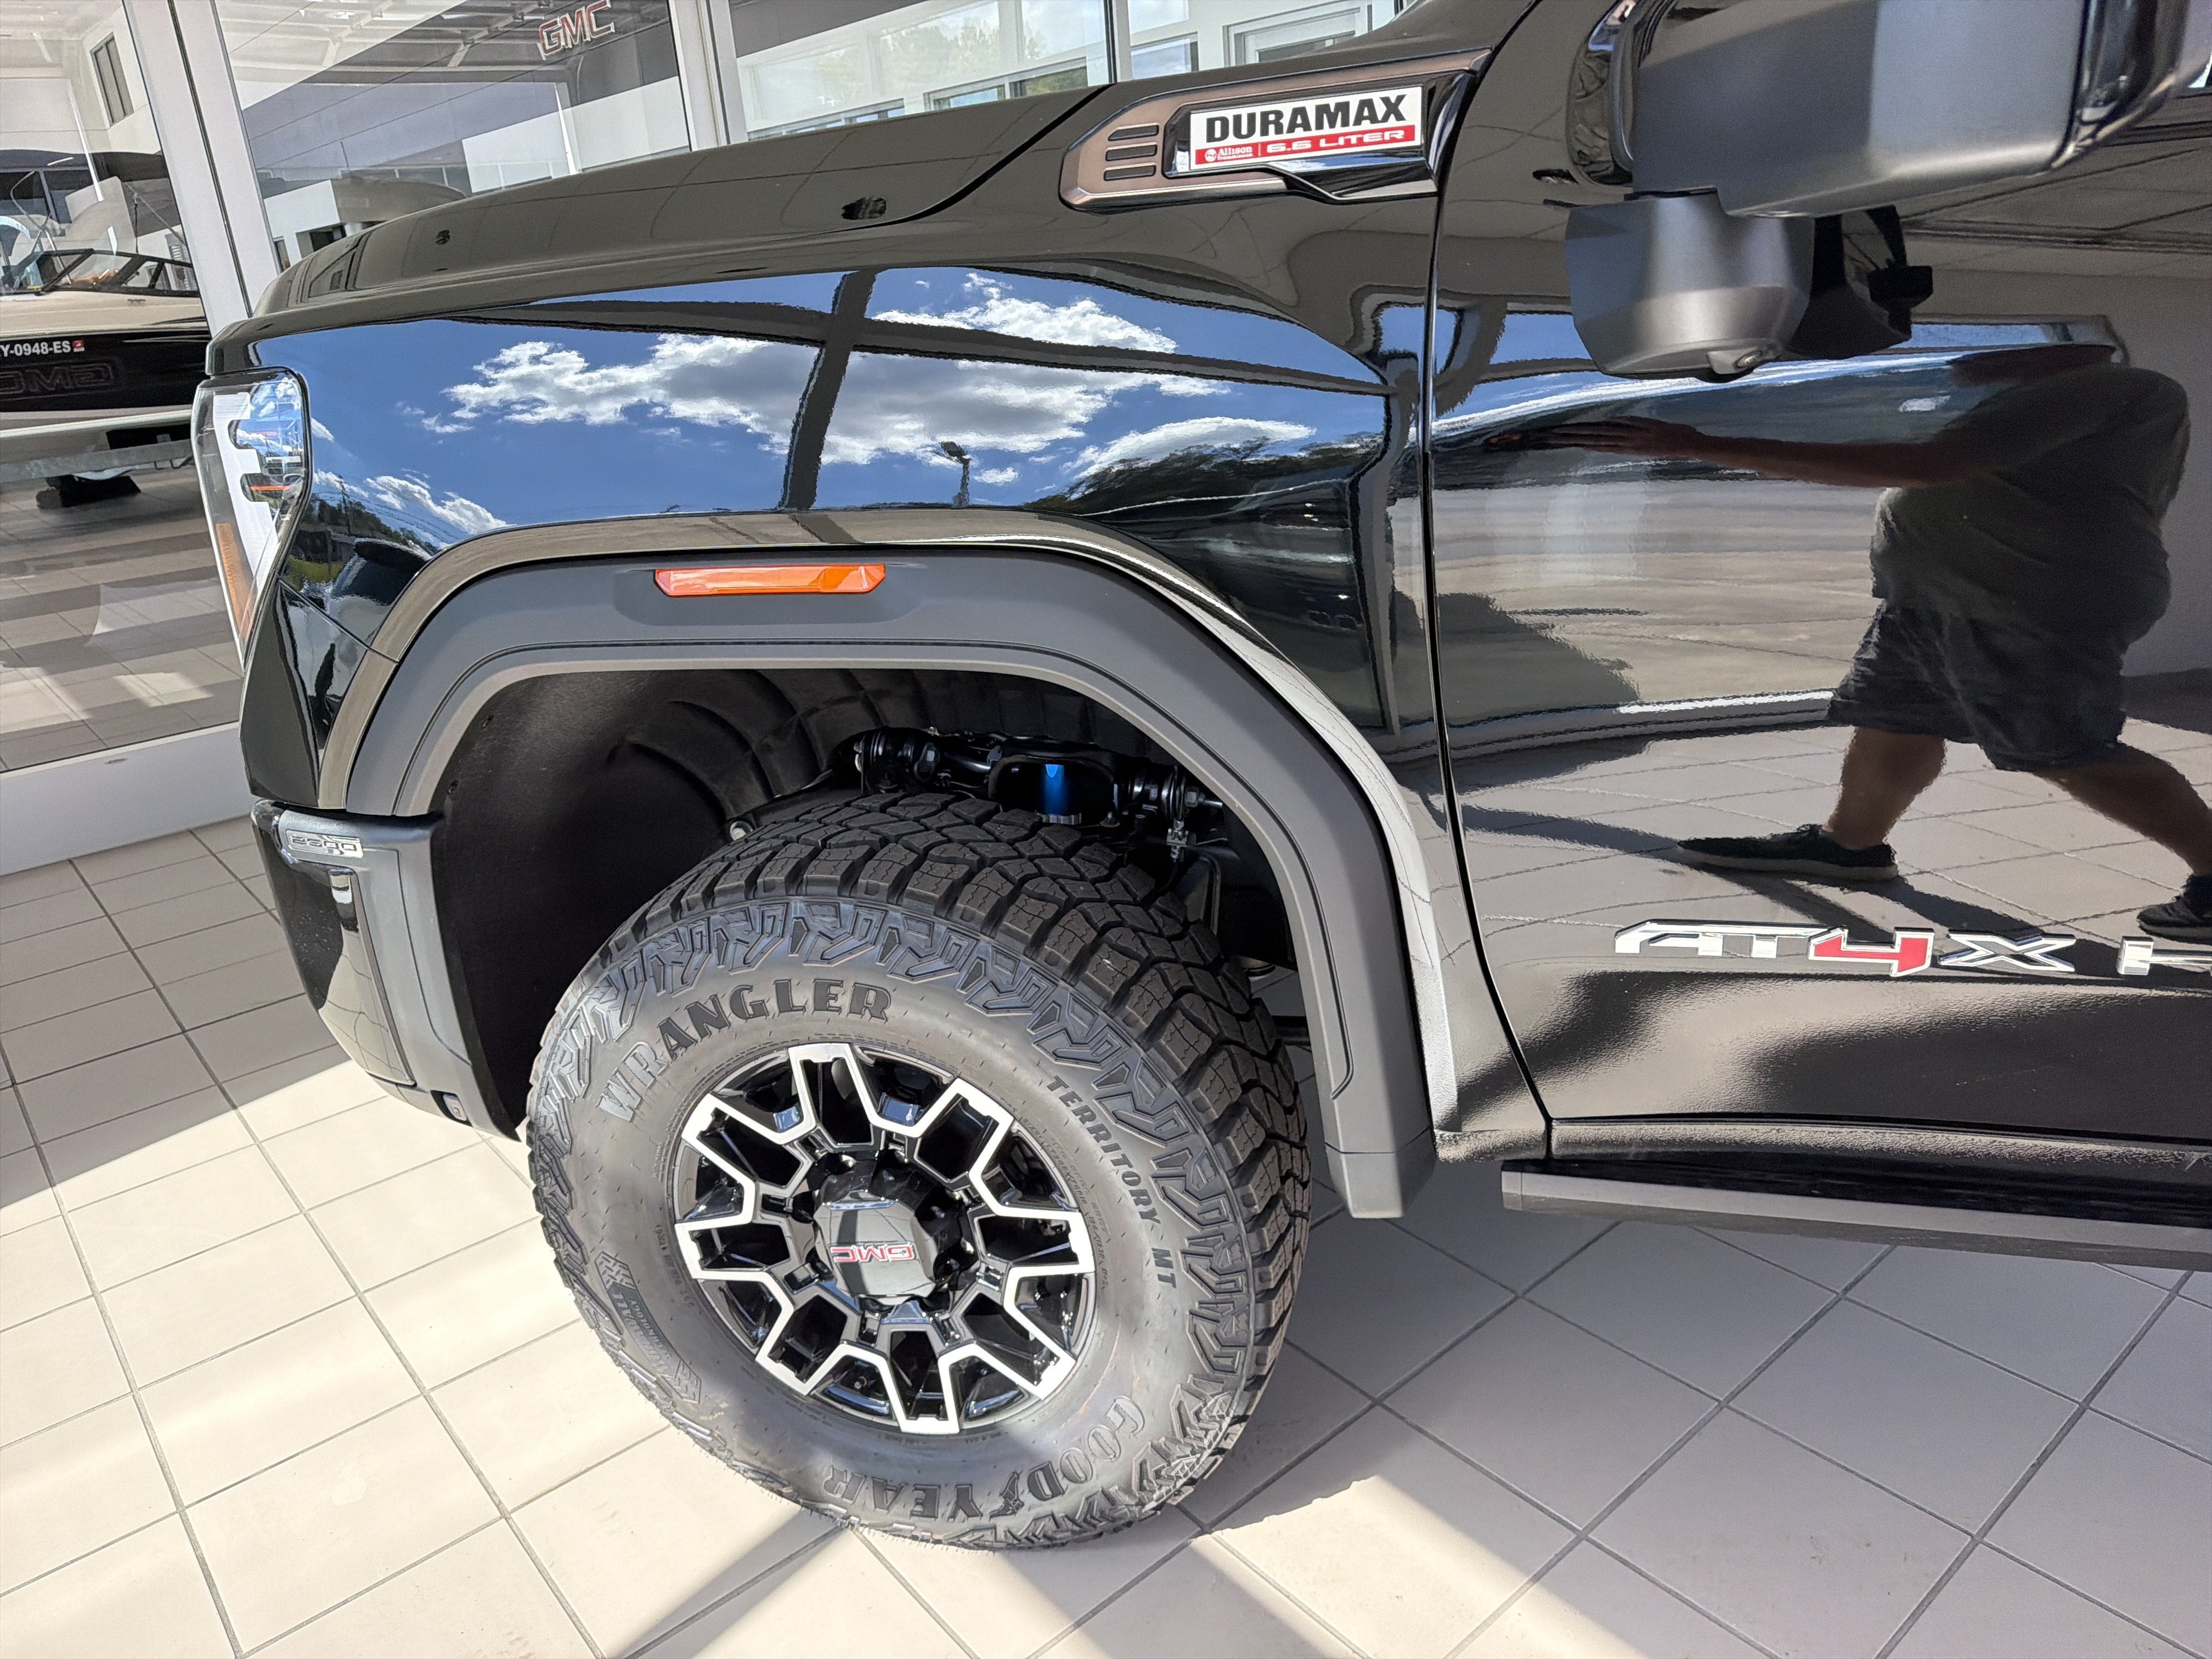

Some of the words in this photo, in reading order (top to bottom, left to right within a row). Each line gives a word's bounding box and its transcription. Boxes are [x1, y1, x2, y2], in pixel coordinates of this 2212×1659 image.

[538, 0, 615, 56] GMC
[1206, 94, 1407, 143] DURAMAX
[1266, 140, 1312, 153] 6.6
[1319, 130, 1405, 148] LITER
[1217, 146, 1253, 156] Allison
[0, 340, 71, 357] Y-0948-ES
[1615, 918, 2076, 977] AT4X
[598, 978, 892, 1122] WRANGLER
[1046, 1075, 1161, 1224] TERRITORY
[1152, 1247, 1177, 1289] MT
[830, 1244, 915, 1263] GMC
